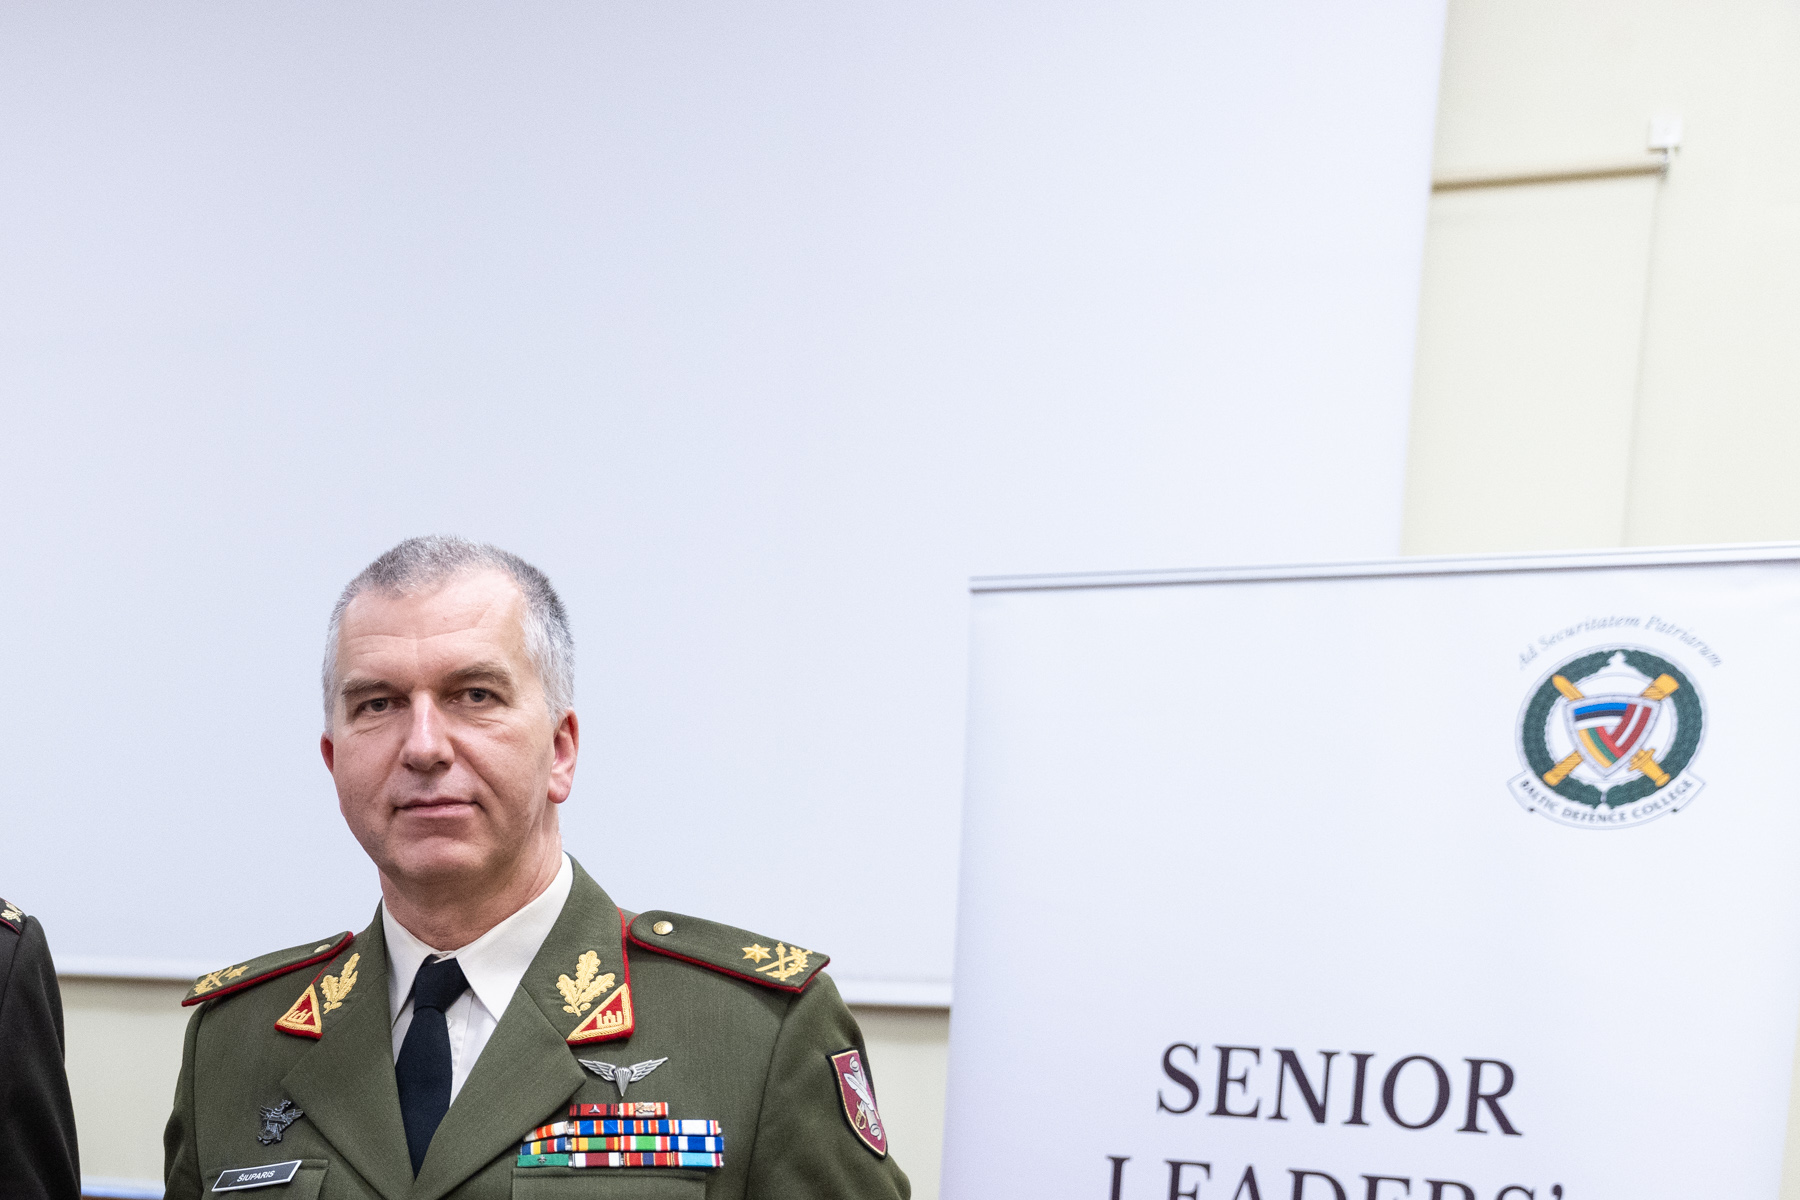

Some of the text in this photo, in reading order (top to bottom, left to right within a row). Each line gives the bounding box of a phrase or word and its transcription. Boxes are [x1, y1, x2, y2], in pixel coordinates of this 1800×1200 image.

[1520, 779, 1693, 823] BALTIC DEFENCE COLLEGE
[1156, 1040, 1524, 1138] SENIOR
